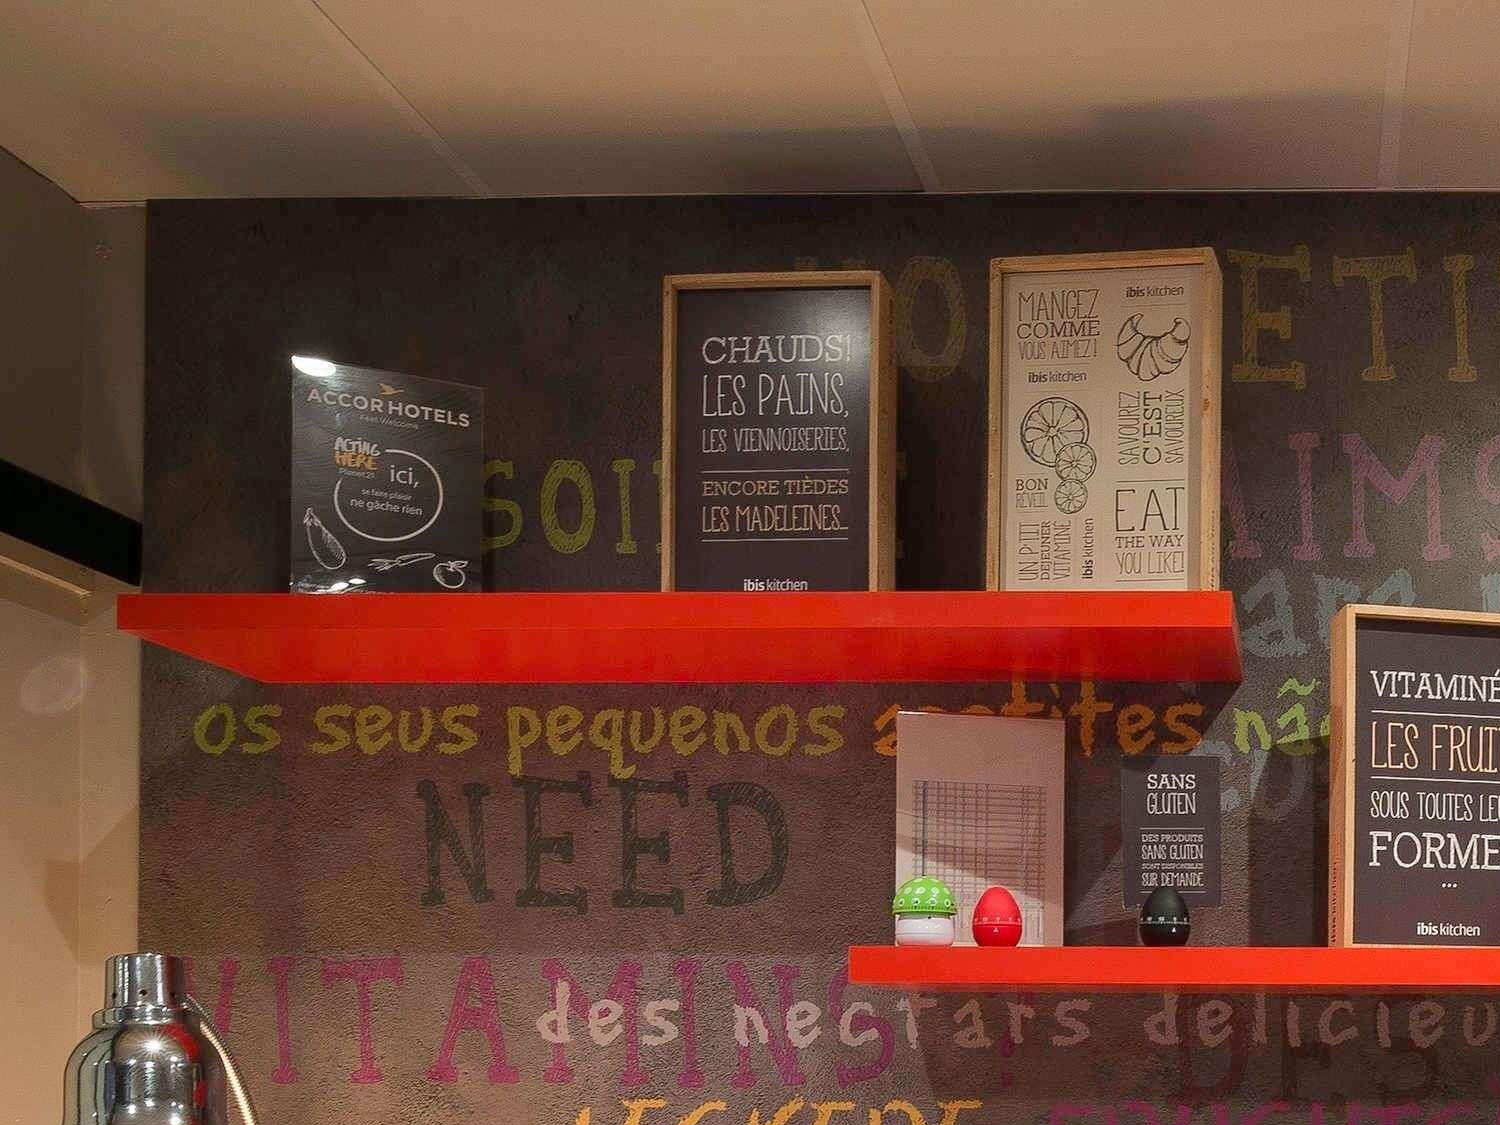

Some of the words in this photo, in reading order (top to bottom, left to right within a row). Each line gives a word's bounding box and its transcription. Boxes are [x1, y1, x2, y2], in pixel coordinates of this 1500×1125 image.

[1126, 287, 1145, 297] ibis
[1147, 285, 1183, 296] kitchen
[1018, 289, 1099, 321] MANGEZ
[1017, 320, 1100, 339] COMME
[702, 334, 851, 364] CHAUDS!
[1019, 340, 1046, 360] VOUS
[1028, 372, 1048, 383] ibis
[1050, 371, 1087, 382] kitchen
[702, 374, 746, 416] LES
[758, 372, 849, 418] PAINS,
[388, 402, 471, 428] HOTELS
[1164, 389, 1185, 464] SAVOUREUX
[702, 429, 727, 453] LES
[734, 426, 850, 453] VIENNOISERIES,
[1119, 391, 1140, 465] SAVOUREZ
[1143, 391, 1162, 465] C'EST
[334, 453, 378, 471] HERE
[389, 464, 420, 488] ici,
[702, 480, 781, 496] ENCORE
[786, 475, 849, 495] TIÈDES
[1015, 478, 1048, 491] BON
[350, 498, 365, 509] ne
[366, 499, 401, 514] gâche
[402, 504, 423, 516] rien
[1115, 487, 1185, 532] EAT
[702, 506, 729, 532] LES
[1082, 518, 1094, 559] kitchen
[1116, 536, 1145, 549] THE
[1149, 535, 1184, 548] WAY
[1018, 559, 1039, 581] UN
[1082, 560, 1094, 579] ibis
[1115, 552, 1142, 575] YOU
[1147, 551, 1185, 573] LIKE!
[743, 578, 765, 592] ibis
[766, 578, 808, 592] kitchen
[193, 702, 283, 756] os
[308, 702, 482, 756] seus
[508, 702, 848, 780] pequenos
[1371, 721, 1419, 771] LES
[1147, 774, 1196, 790] SANS
[1147, 792, 1196, 815] GLUTEN
[1370, 790, 1410, 820] SOUS
[1417, 792, 1474, 822] TOUTES
[417, 771, 791, 914] NEED
[1142, 834, 1160, 842] DES
[1160, 834, 1203, 842] PRODUITS
[1141, 844, 1167, 860] SANS
[1170, 844, 1203, 860] GLUTEN
[1142, 872, 1158, 886] SUR
[1161, 872, 1204, 886] DEMANDE
[1416, 923, 1440, 936] ibis
[1440, 923, 1481, 937] kitchen
[537, 982, 679, 1046] des
[734, 992, 1091, 1050] nectars
